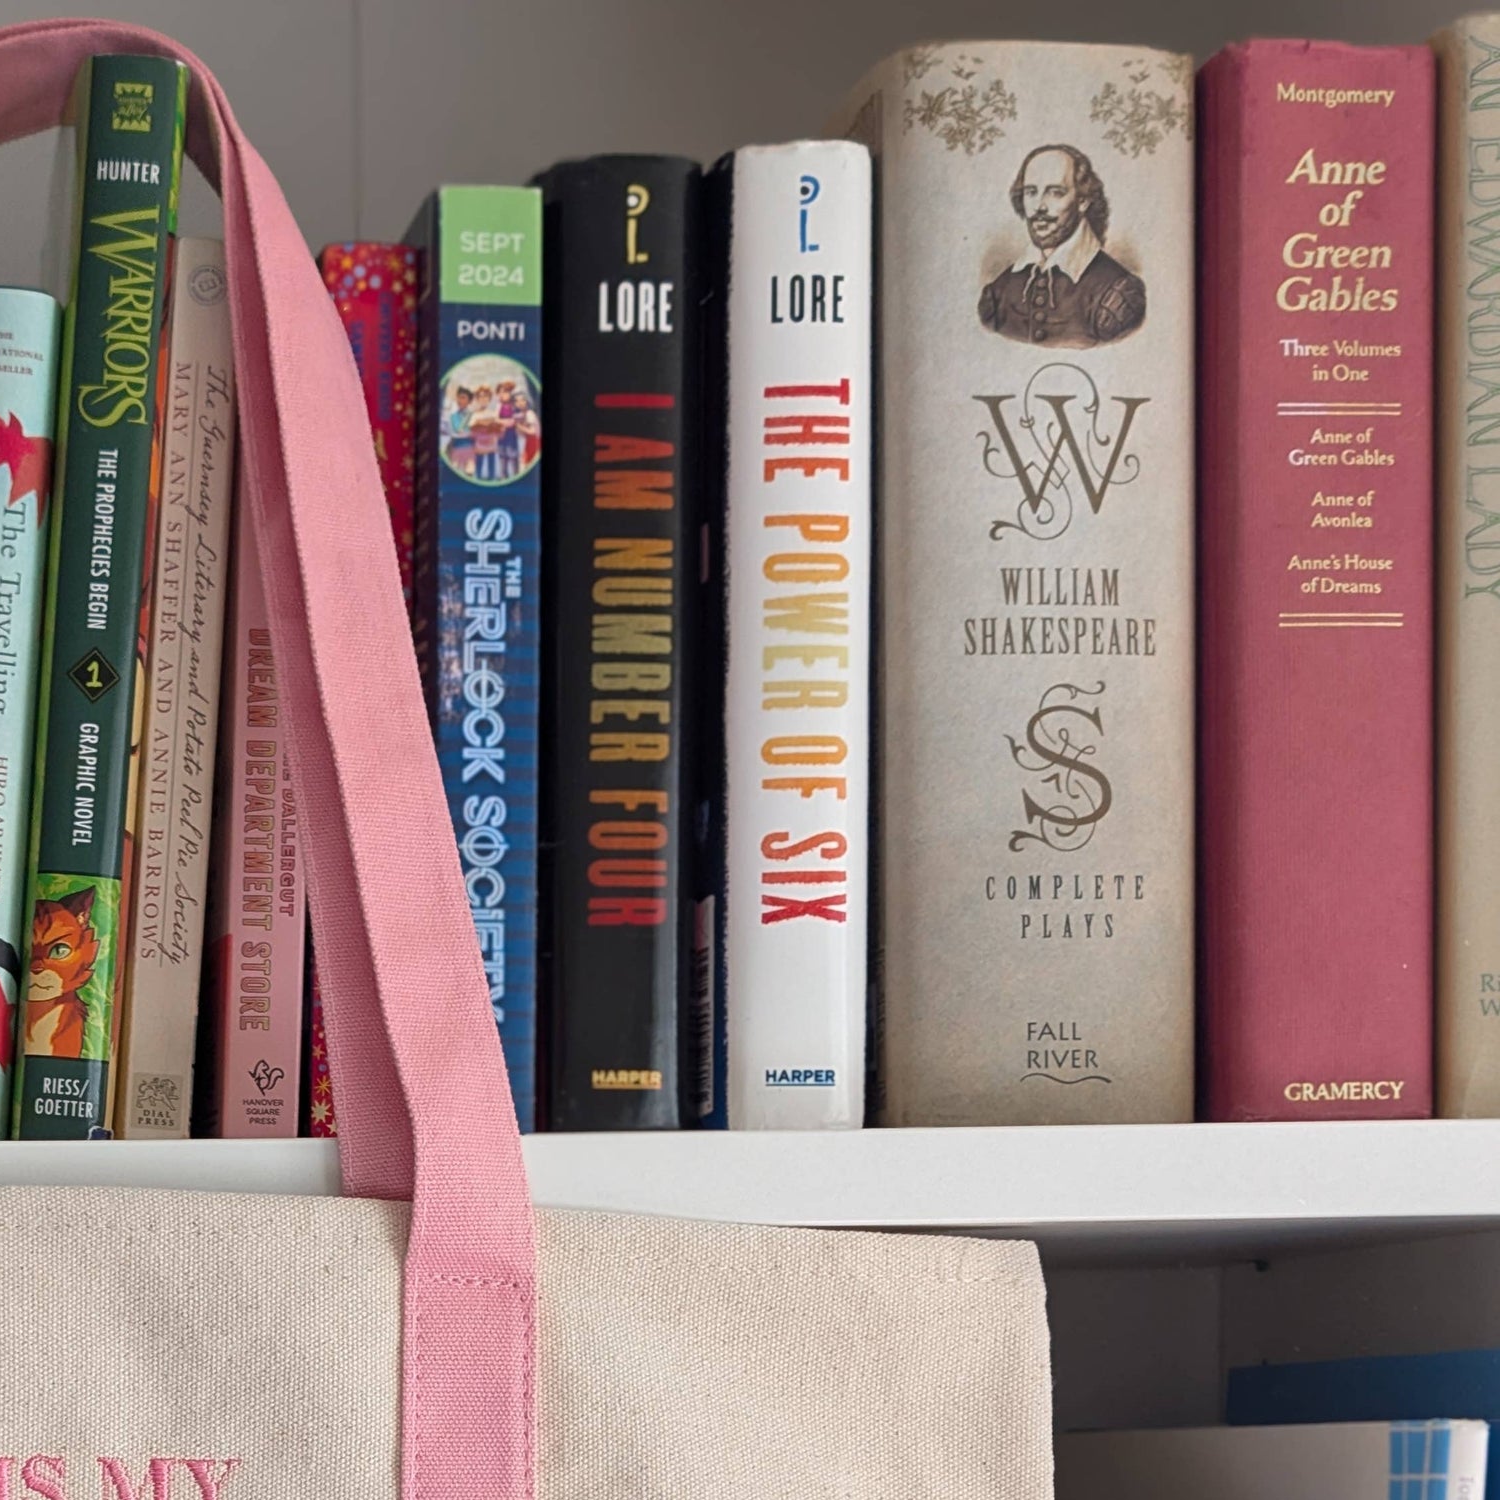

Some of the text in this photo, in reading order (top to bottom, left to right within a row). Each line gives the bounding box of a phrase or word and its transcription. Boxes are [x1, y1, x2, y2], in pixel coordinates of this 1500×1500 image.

[1277, 83, 1395, 108] Montgomery
[96, 160, 160, 185] HUNTER
[1286, 148, 1386, 185] Anne
[1319, 190, 1363, 227] of
[460, 232, 525, 254] SEPT
[1282, 232, 1392, 268] Green
[458, 264, 525, 287] 2024
[771, 274, 845, 323] LORE
[1276, 276, 1398, 312] Gables
[77, 204, 160, 428] WARRIORS
[599, 281, 673, 333] LORE
[457, 320, 525, 341] PONTI
[1280, 338, 1401, 357] Three Volumes
[1333, 364, 1368, 382] One
[1310, 428, 1353, 444] Anne
[1289, 449, 1395, 466] Green Gables
[1311, 491, 1354, 506] Anne
[1311, 512, 1373, 528] Avonlea
[87, 449, 118, 630] THE PROPHECIES BEGIN
[1288, 554, 1393, 570] Anne's House
[1000, 568, 1120, 607] WILLIAM
[1321, 577, 1381, 594] Dreams
[461, 509, 513, 784] SHERLOCK
[963, 618, 1157, 656] SHAKESPEARE
[140, 363, 190, 959] MARY ANN SHAFFER ANNIE BARROWS
[760, 378, 850, 925] THE POWER OF SIX
[587, 434, 675, 926] AM NUMBER FOUR
[158, 534, 217, 965] Literary Potato Society
[72, 723, 100, 845] GRAPHIC NOVEL
[239, 740, 276, 1031] DEPARTMENT STORE
[986, 875, 1145, 901] COMPLETE
[1021, 914, 1114, 939] PLAYS
[1027, 1022, 1081, 1041] FALL
[1027, 1050, 1098, 1069] RIVER
[765, 1070, 835, 1082] HARPER
[1284, 1081, 1404, 1101] GRAMERCY
[35, 1096, 93, 1119] GOETTER
